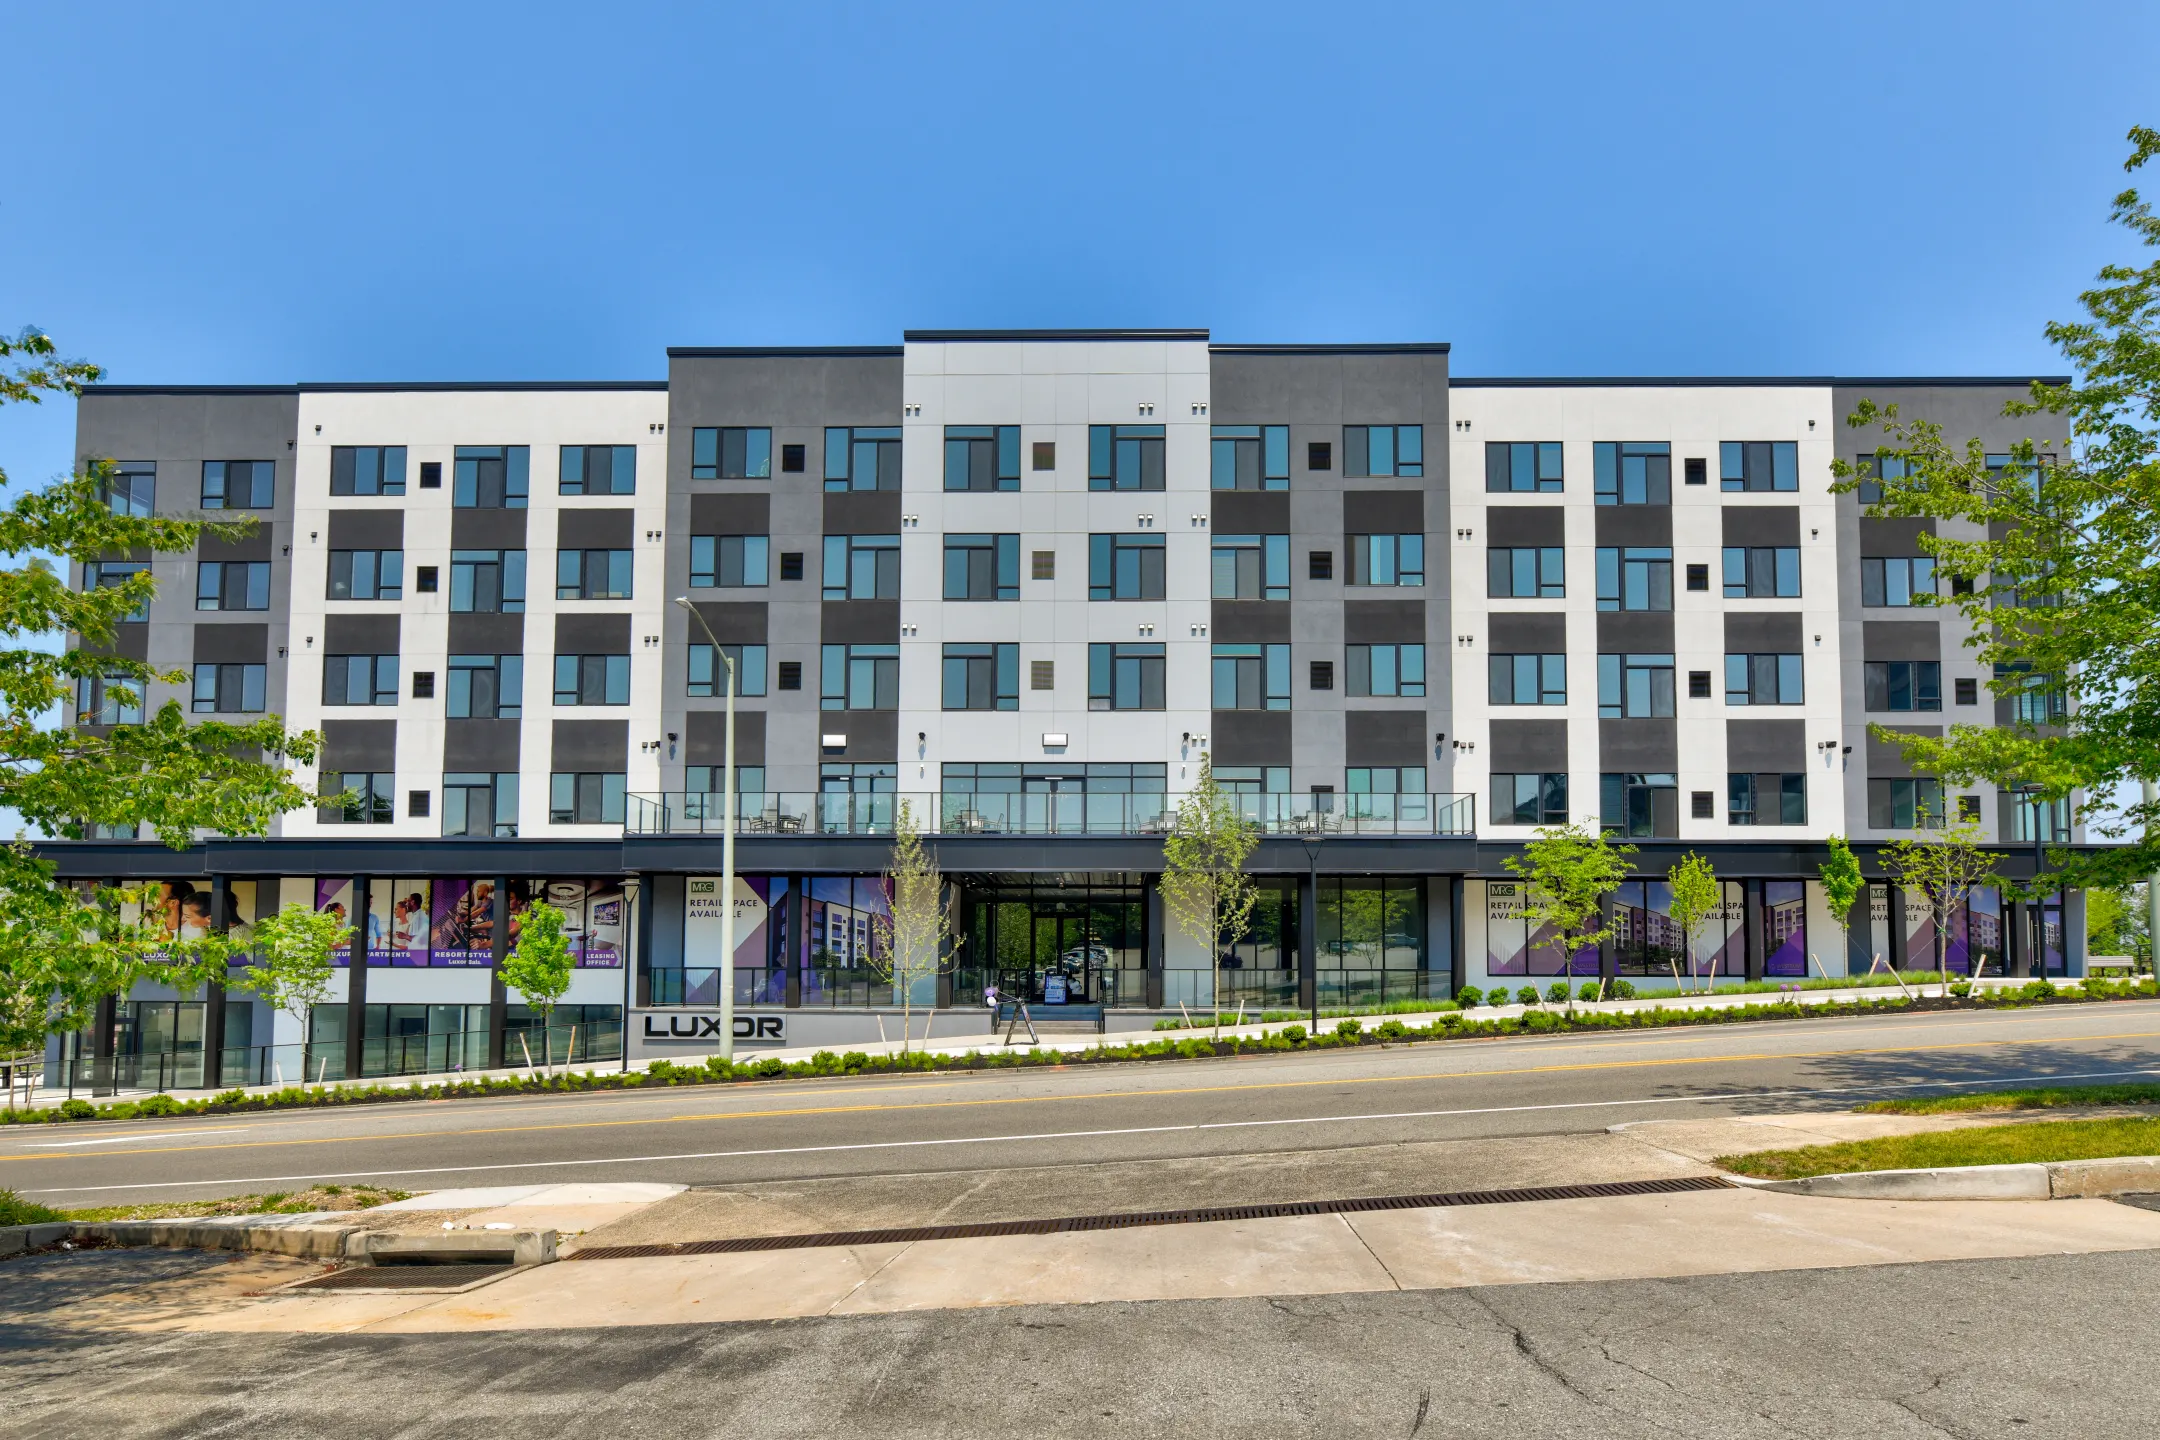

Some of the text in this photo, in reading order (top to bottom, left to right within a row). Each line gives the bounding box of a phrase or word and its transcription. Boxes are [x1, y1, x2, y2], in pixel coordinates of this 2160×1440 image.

[692, 882, 714, 892] MRG
[1491, 885, 1514, 895] MRG
[690, 899, 758, 907] RETAIL PACE
[1490, 901, 1523, 909] RETAIL
[1727, 902, 1744, 910] SPA
[689, 910, 742, 918] AVAILE
[1699, 912, 1741, 920] AILABLE
[143, 951, 169, 959] LUXO
[644, 1016, 784, 1038] LUXOR
